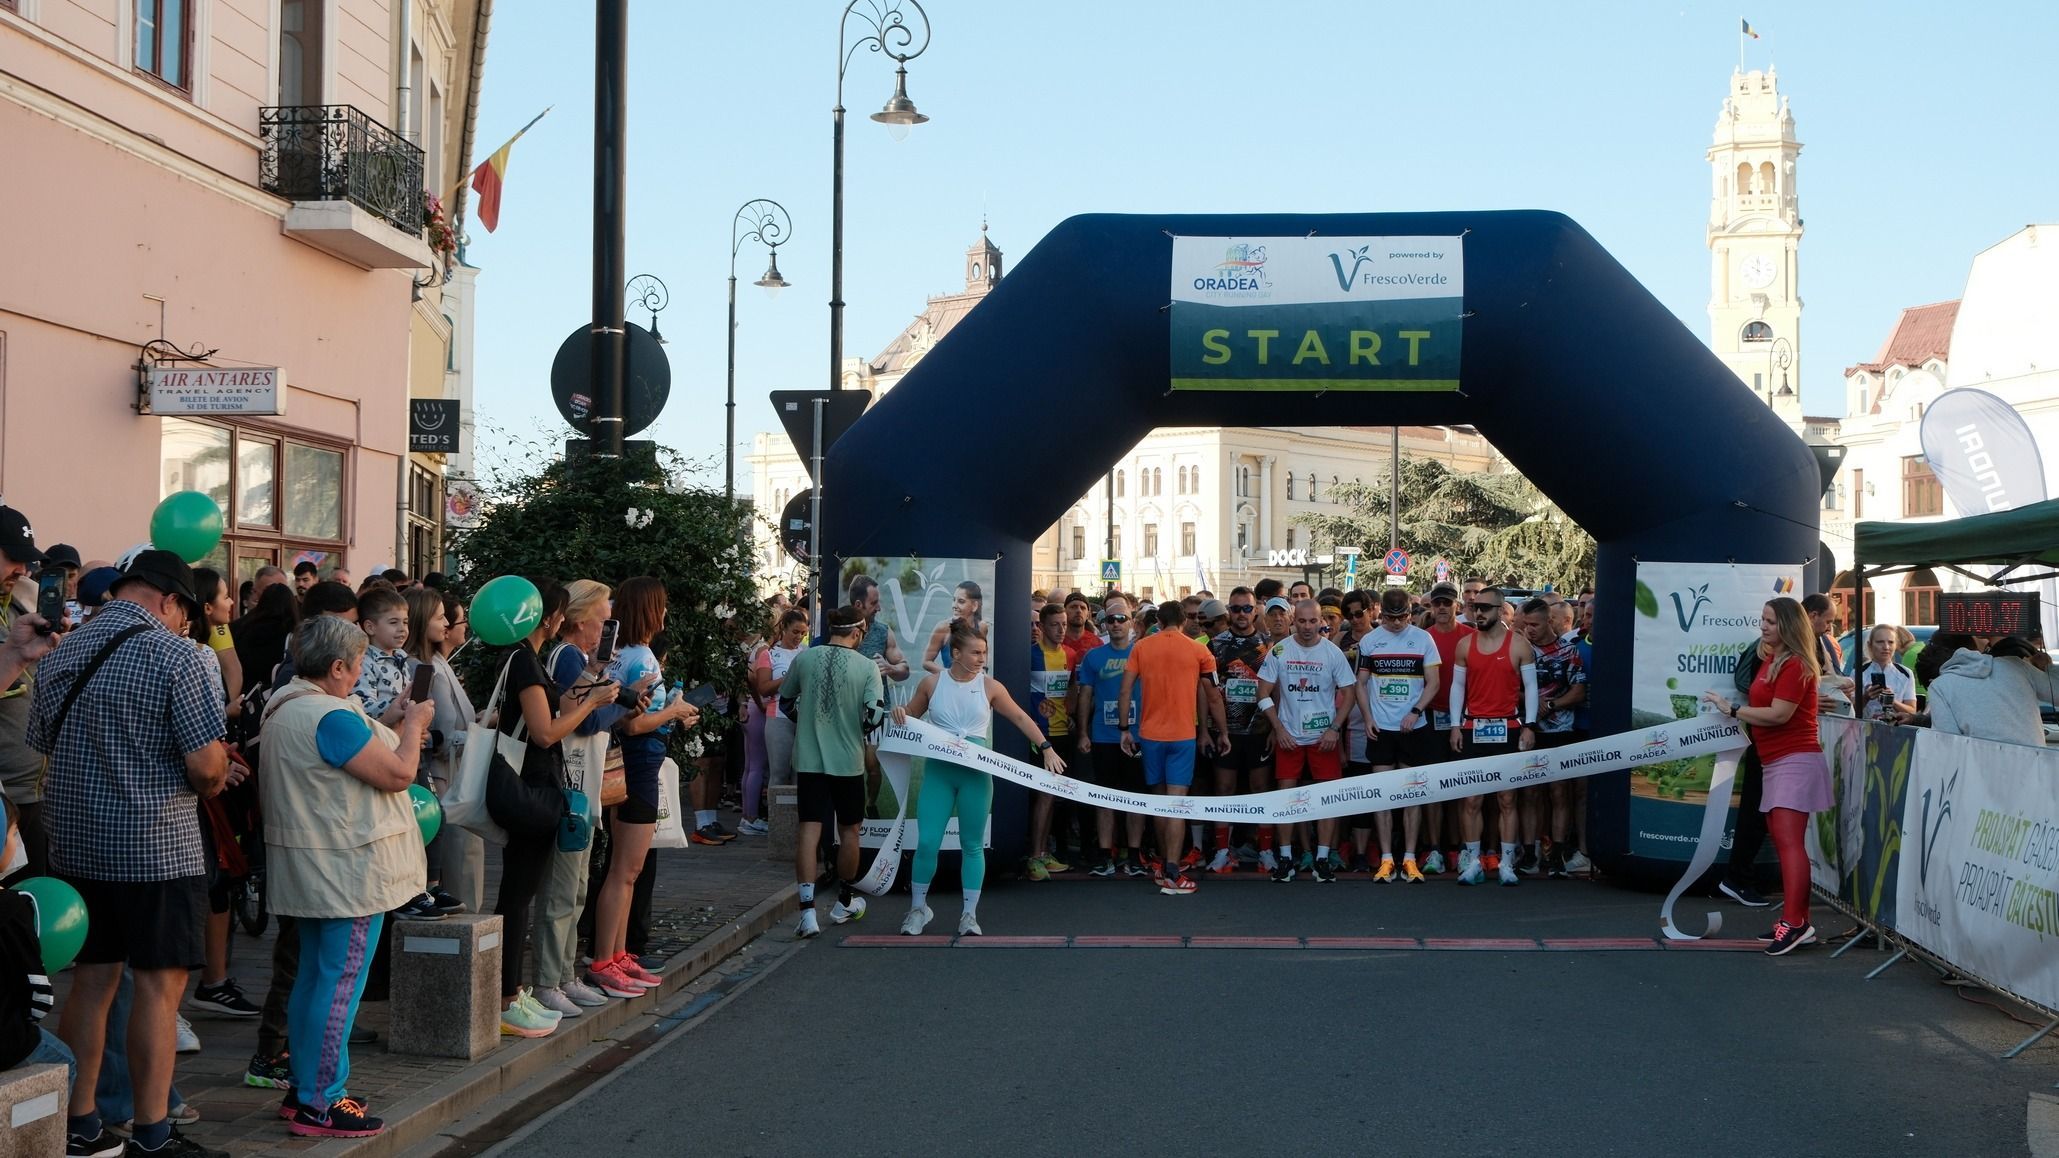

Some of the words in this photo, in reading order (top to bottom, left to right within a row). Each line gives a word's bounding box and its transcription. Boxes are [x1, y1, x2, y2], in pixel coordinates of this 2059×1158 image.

[1389, 251, 1429, 261] powered
[1431, 251, 1444, 261] by
[1193, 278, 1259, 290] ORADEA
[1363, 272, 1448, 285] FrescoVerde
[1202, 328, 1431, 366] START
[157, 372, 189, 387] AIR
[191, 371, 273, 386] ANTARES
[410, 434, 450, 445] TED'S
[1268, 549, 1307, 567] DOCK
[1374, 660, 1416, 668] DEWSBURY
[1238, 687, 1256, 695] 344
[1389, 685, 1408, 694] 390
[1313, 718, 1329, 728] 360
[1696, 723, 1723, 734] IZVORUL
[1486, 726, 1505, 735] 119
[1679, 725, 1740, 748] MINUNILOR
[928, 743, 963, 758] ORADEA
[1578, 749, 1604, 758] IZVORUL
[1629, 750, 1667, 762] ORADEA
[1560, 750, 1622, 770] MINUNILOR
[976, 753, 1033, 780] MINUNILOR
[1457, 769, 1485, 777] IZVORUL
[1509, 772, 1547, 783] ORADEA
[1439, 771, 1502, 790] MINUNILOR
[1039, 782, 1075, 796] ORADEA
[1088, 791, 1147, 808] MINUNILOR
[1320, 787, 1382, 806] MINUNILOR
[1389, 790, 1427, 802] ORADEA
[1154, 807, 1191, 815] ORADEA
[1204, 805, 1265, 815] MINUNILOR
[1272, 807, 1308, 818] ORADEA
[1640, 830, 1700, 843] frescoverde.ro
[1971, 809, 2032, 860] PROASPĂT
[1956, 861, 2013, 918] PROASPĂT
